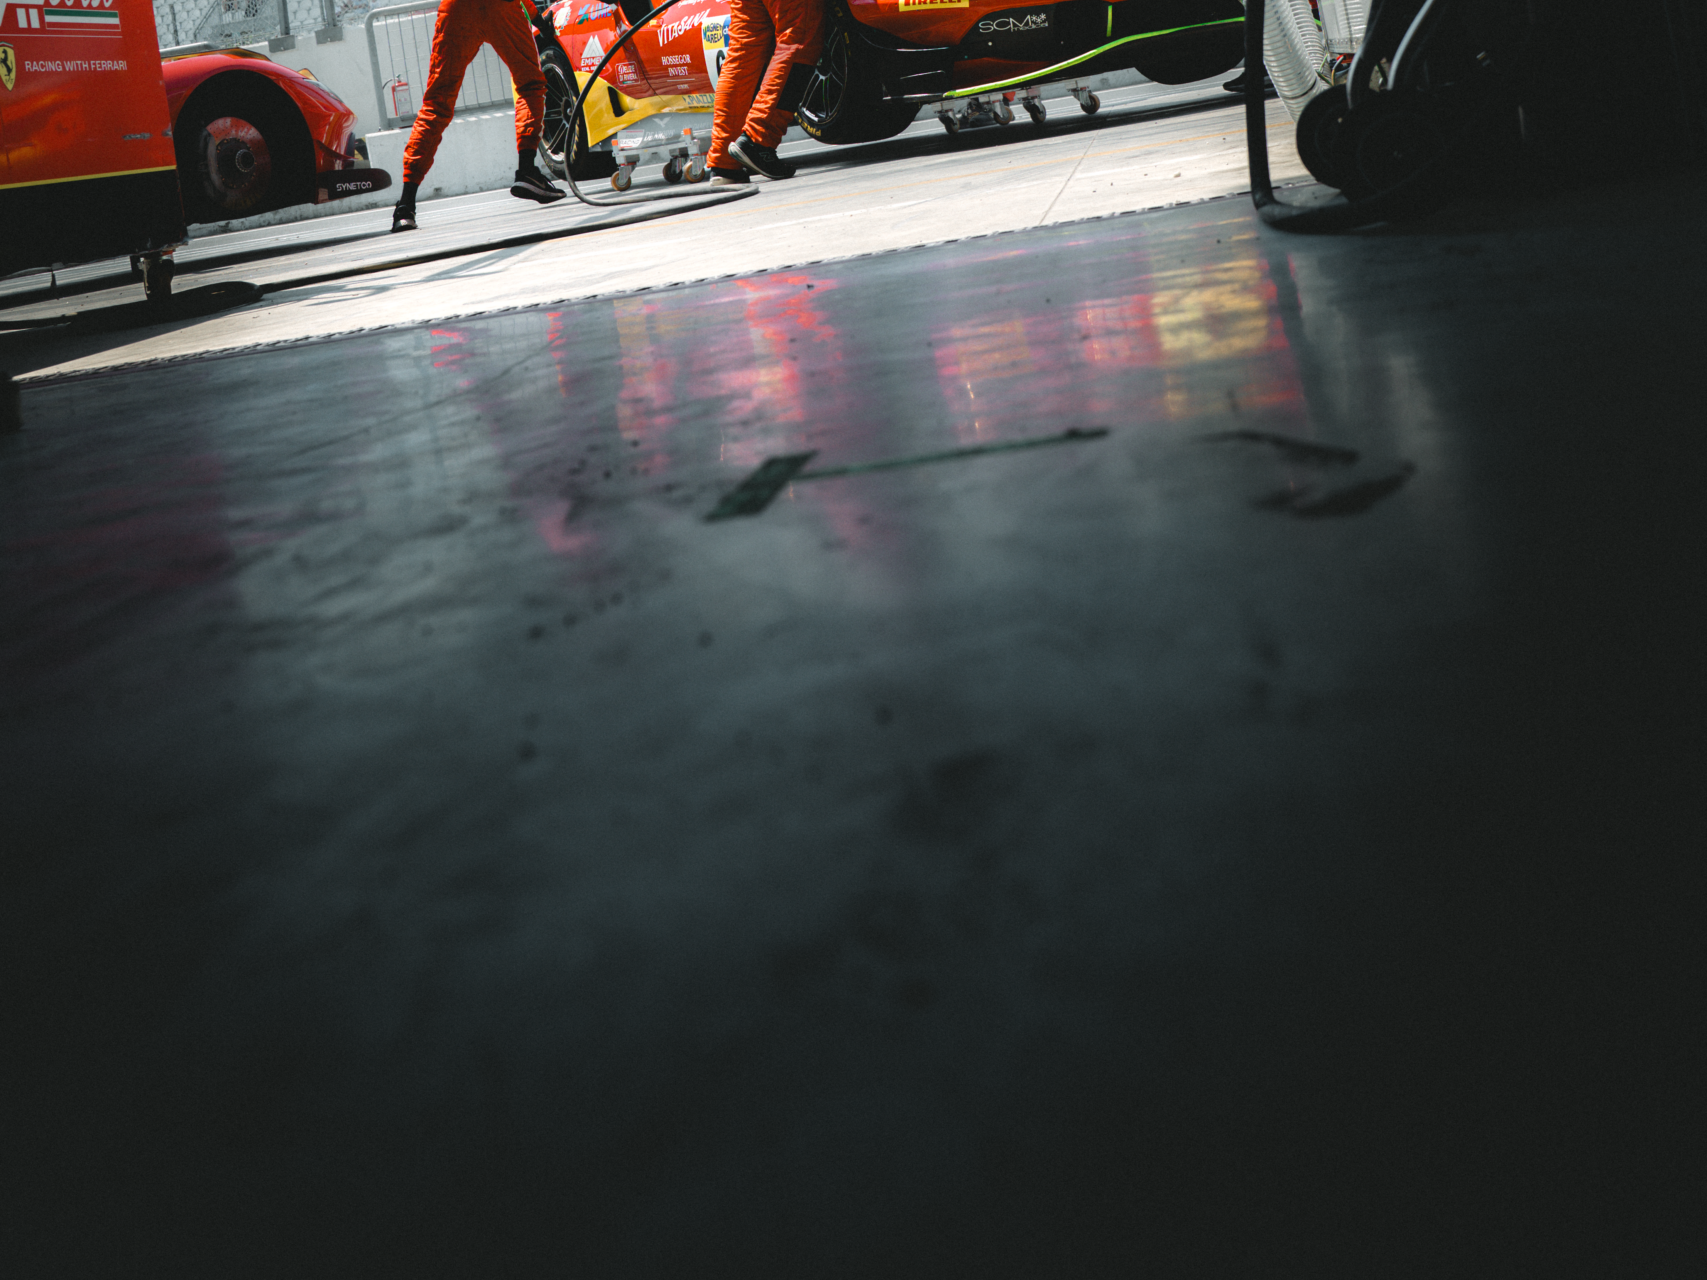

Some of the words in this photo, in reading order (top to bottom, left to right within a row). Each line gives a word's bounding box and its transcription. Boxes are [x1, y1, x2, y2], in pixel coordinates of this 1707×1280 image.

[979, 15, 1032, 32] SCM
[661, 54, 691, 65] HOSSEGOR
[25, 61, 63, 72] RACING
[64, 61, 89, 71] WITH
[90, 61, 127, 71] FERRARI
[668, 67, 688, 76] INVEST
